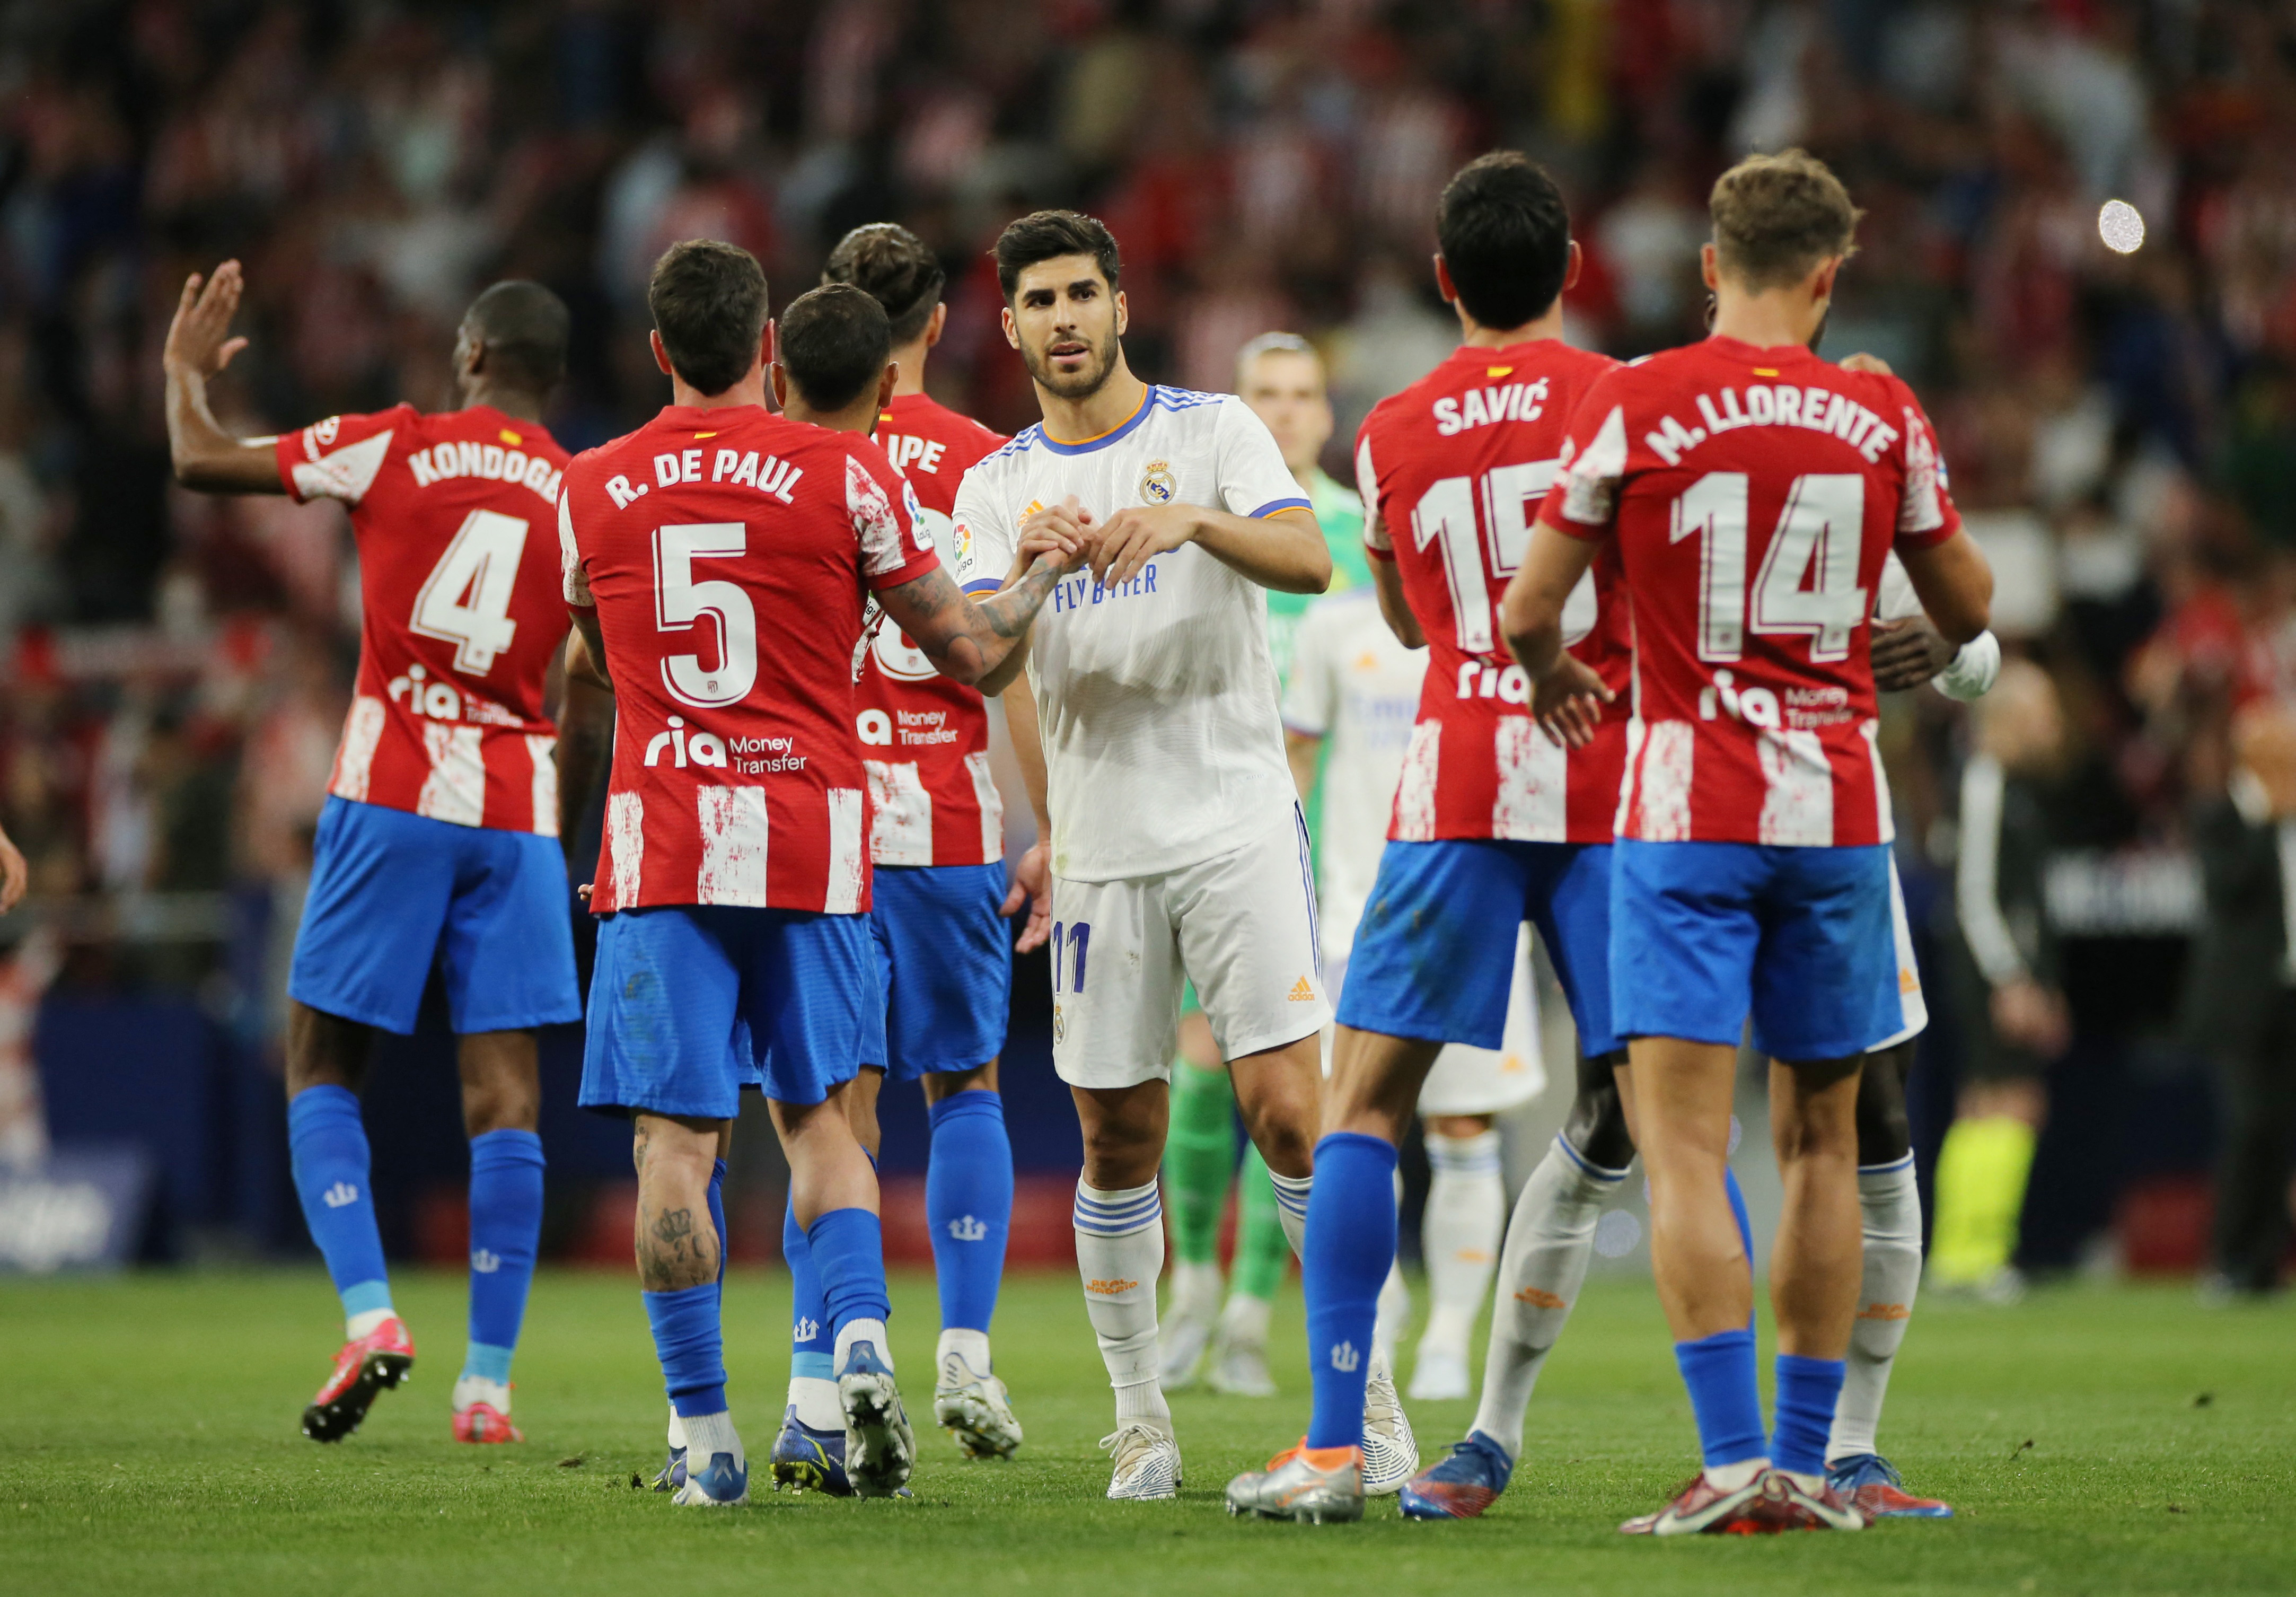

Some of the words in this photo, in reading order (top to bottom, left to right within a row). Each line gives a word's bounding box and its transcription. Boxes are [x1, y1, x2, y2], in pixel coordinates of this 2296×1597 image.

[1433, 377, 1550, 436] SAVIĆ
[605, 475, 649, 510] R.
[653, 449, 704, 489] DE
[711, 449, 804, 505] PAUL
[870, 432, 947, 475] IPE
[409, 508, 530, 677] 4
[1669, 471, 1867, 663] 14
[652, 522, 758, 708] 5
[1055, 578, 1086, 613] FLY
[388, 663, 460, 720] ria
[896, 709, 947, 727] Money
[644, 715, 727, 768] ria
[729, 736, 793, 754] Money
[898, 726, 958, 745] Transfer
[734, 753, 807, 774] Transfer
[1051, 921, 1090, 996] 11
